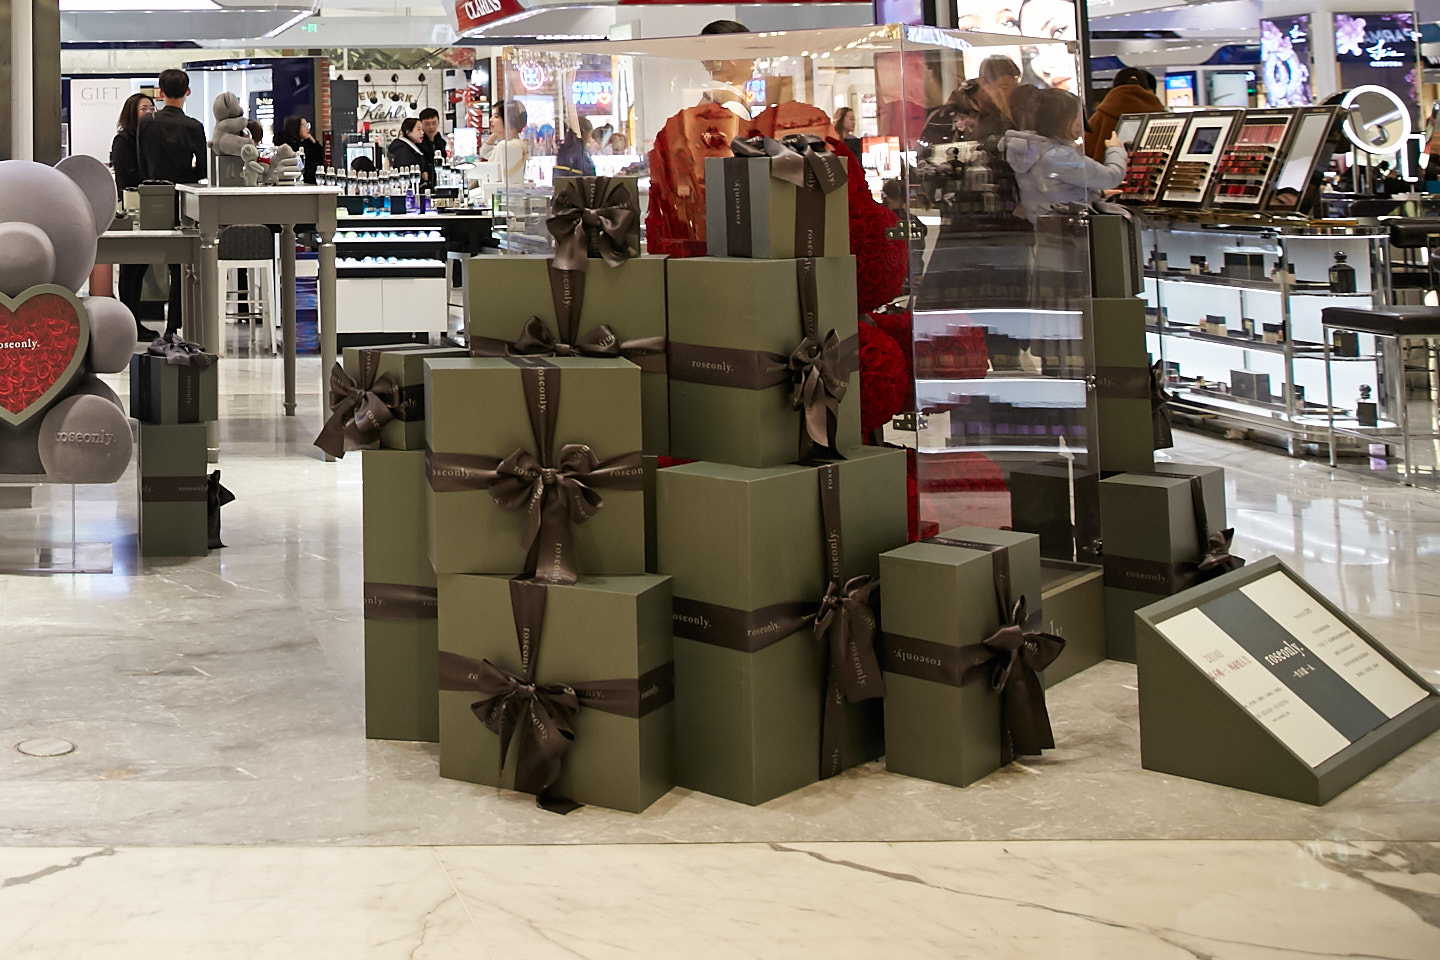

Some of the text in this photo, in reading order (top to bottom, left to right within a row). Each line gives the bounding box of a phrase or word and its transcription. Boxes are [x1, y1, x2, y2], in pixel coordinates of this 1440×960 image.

[81, 86, 121, 100] GIFT
[360, 104, 408, 120] Kiehl's
[691, 359, 734, 374] roseonly.
[827, 529, 840, 579] roseonly.
[747, 620, 781, 637] roseonly.
[1264, 639, 1306, 667] roseonly.
